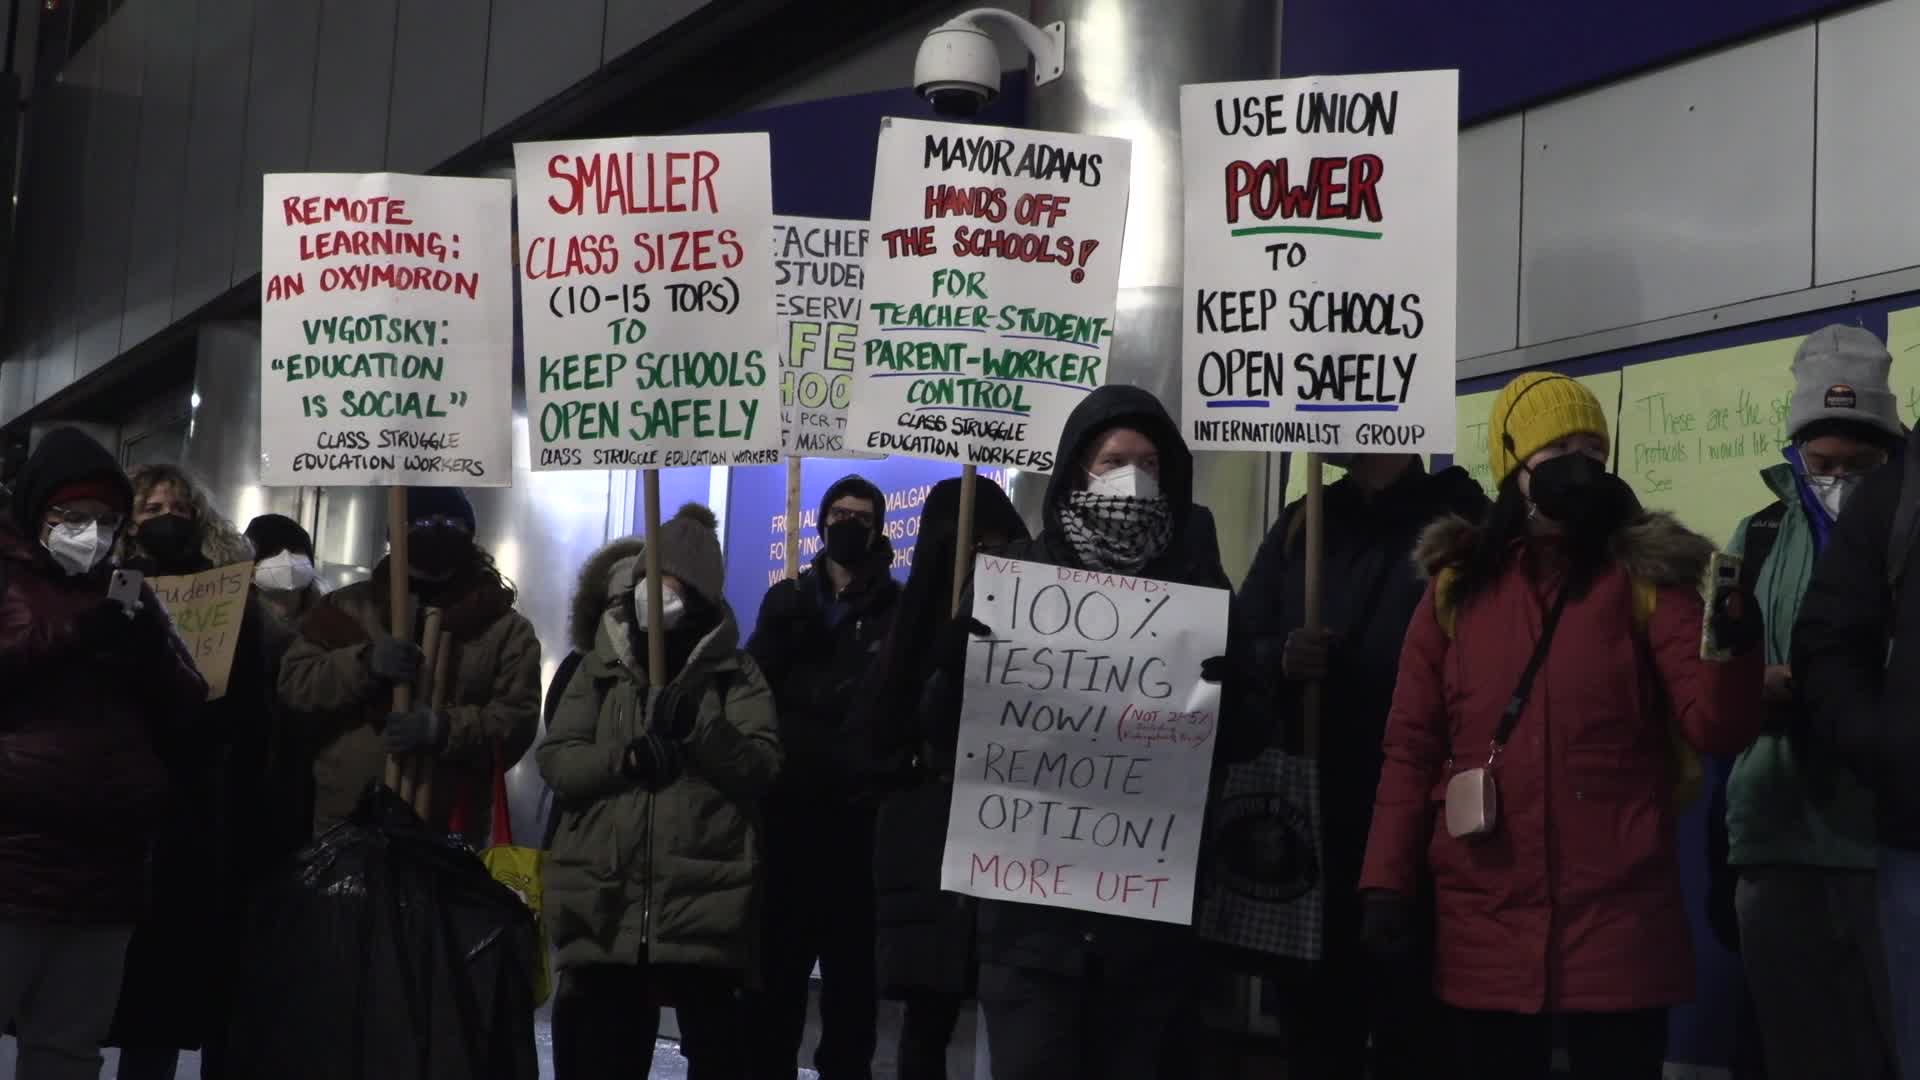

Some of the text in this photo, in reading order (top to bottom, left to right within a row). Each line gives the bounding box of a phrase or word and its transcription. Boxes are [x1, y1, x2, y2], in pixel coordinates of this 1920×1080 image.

[1216, 90, 1398, 137] USE UNION
[924, 134, 1103, 187] MAYOR ADAMS
[547, 150, 720, 216] SMALLER
[1225, 153, 1384, 224] POWER
[283, 196, 413, 226] REMOTE
[924, 184, 1070, 228] HANDS OFF
[300, 230, 460, 263] LEARNING:
[525, 229, 744, 281] CLASS SIZES
[882, 226, 1099, 284] THE SCHOOLS!
[1264, 242, 1307, 271] TO
[266, 264, 479, 302] AN OXYMORON
[549, 276, 740, 318] (10-15 TOPS)
[932, 269, 989, 300] FOR
[302, 314, 449, 346] VYGOTSKY:
[608, 317, 647, 345] TO
[1196, 288, 1424, 339] KEEP SCHOOLS
[779, 321, 858, 371] FE
[539, 350, 766, 393] KEEP SCHOOLS
[1198, 349, 1417, 403] OPEN SAFELY
[302, 394, 328, 418] IS
[906, 378, 1032, 412] CONTROL
[1635, 392, 1697, 434] These
[1706, 408, 1729, 431] are
[1736, 385, 1762, 426] the
[539, 398, 759, 443] OPEN SAFELY
[801, 412, 829, 427] PCR
[898, 412, 1028, 442] CLASS STRUGGLE
[1194, 419, 1425, 446] INTERNATIONALIST GROUP
[317, 429, 460, 450] CLASS STRUGGLE
[540, 448, 779, 467] CLASS STRUGGLE EDUCATION WORKERS
[795, 433, 843, 451] MASKS
[867, 431, 1054, 472] EDUCATION WORKERS
[1709, 433, 1745, 460] would
[292, 453, 485, 476] EDUCATION WORKERS
[1645, 470, 1673, 493] See
[884, 483, 937, 512] MALGA
[983, 558, 1169, 593] WE DEMAND:
[972, 638, 1173, 700] TESTING
[1000, 700, 1107, 743] NOW!
[983, 743, 1152, 795] REMOTE
[978, 794, 1175, 863] OPTION!
[970, 853, 1169, 909] MORE UFT
